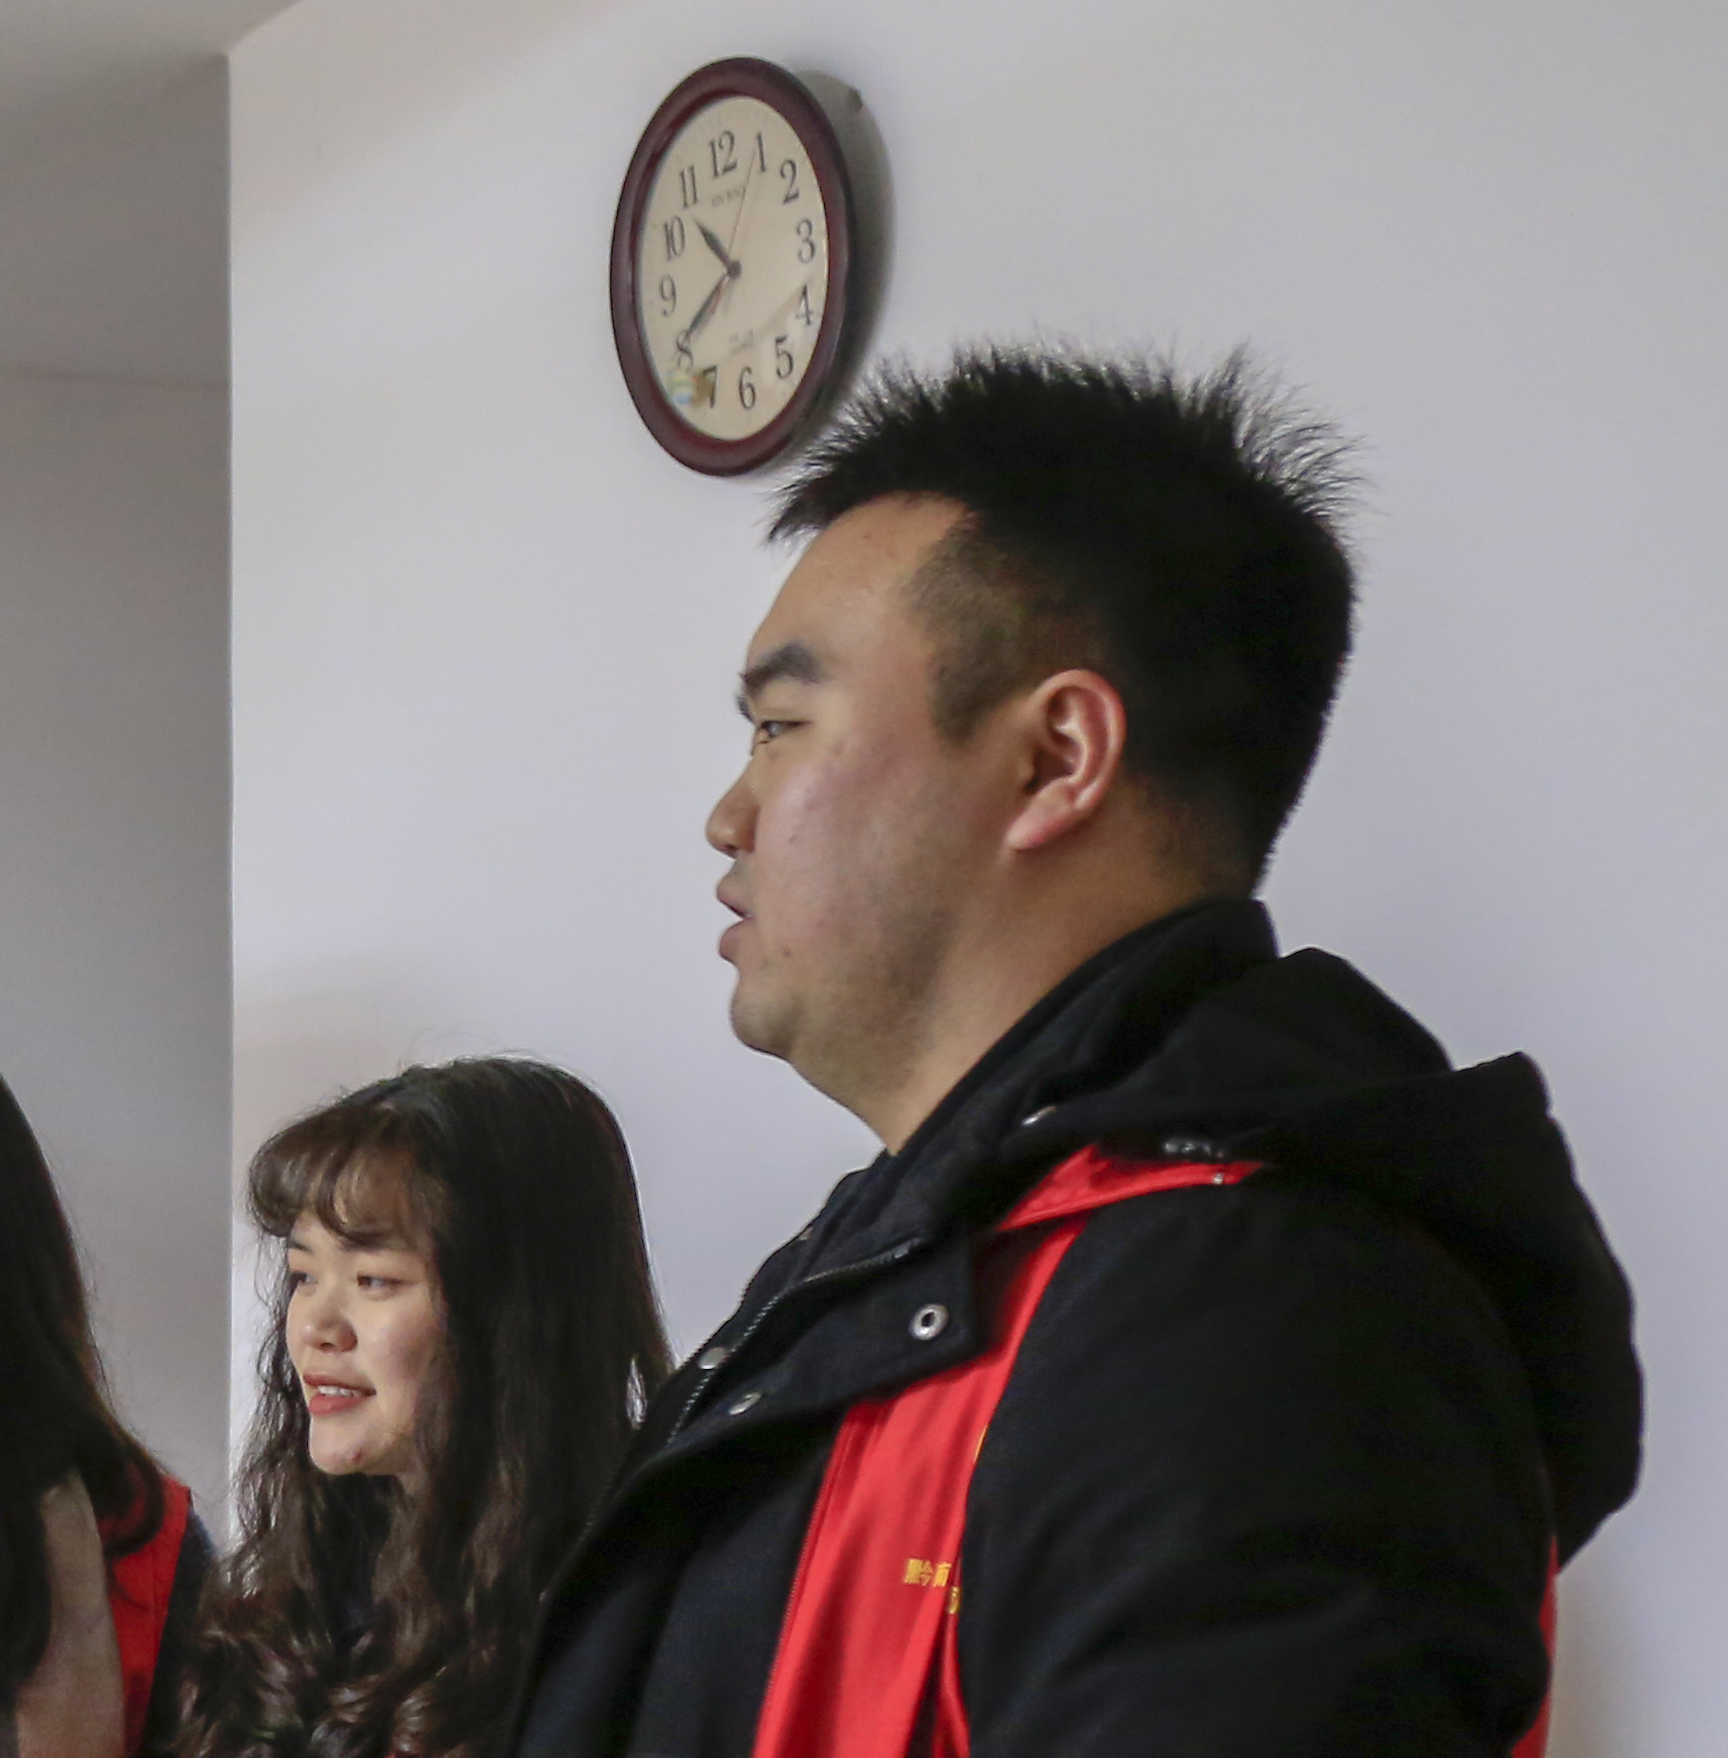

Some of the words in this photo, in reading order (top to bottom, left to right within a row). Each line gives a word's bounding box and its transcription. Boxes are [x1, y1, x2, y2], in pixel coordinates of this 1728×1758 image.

[708, 130, 738, 178] 12
[754, 132, 767, 173] 1
[679, 165, 699, 208] 11
[780, 159, 800, 205] 2
[662, 215, 685, 262] 10
[796, 219, 815, 263] 3
[659, 275, 676, 317] 9
[794, 283, 813, 327] 4
[675, 331, 694, 371] 8
[774, 336, 794, 380] 5
[702, 366, 717, 408] 7
[738, 366, 756, 410] 6
